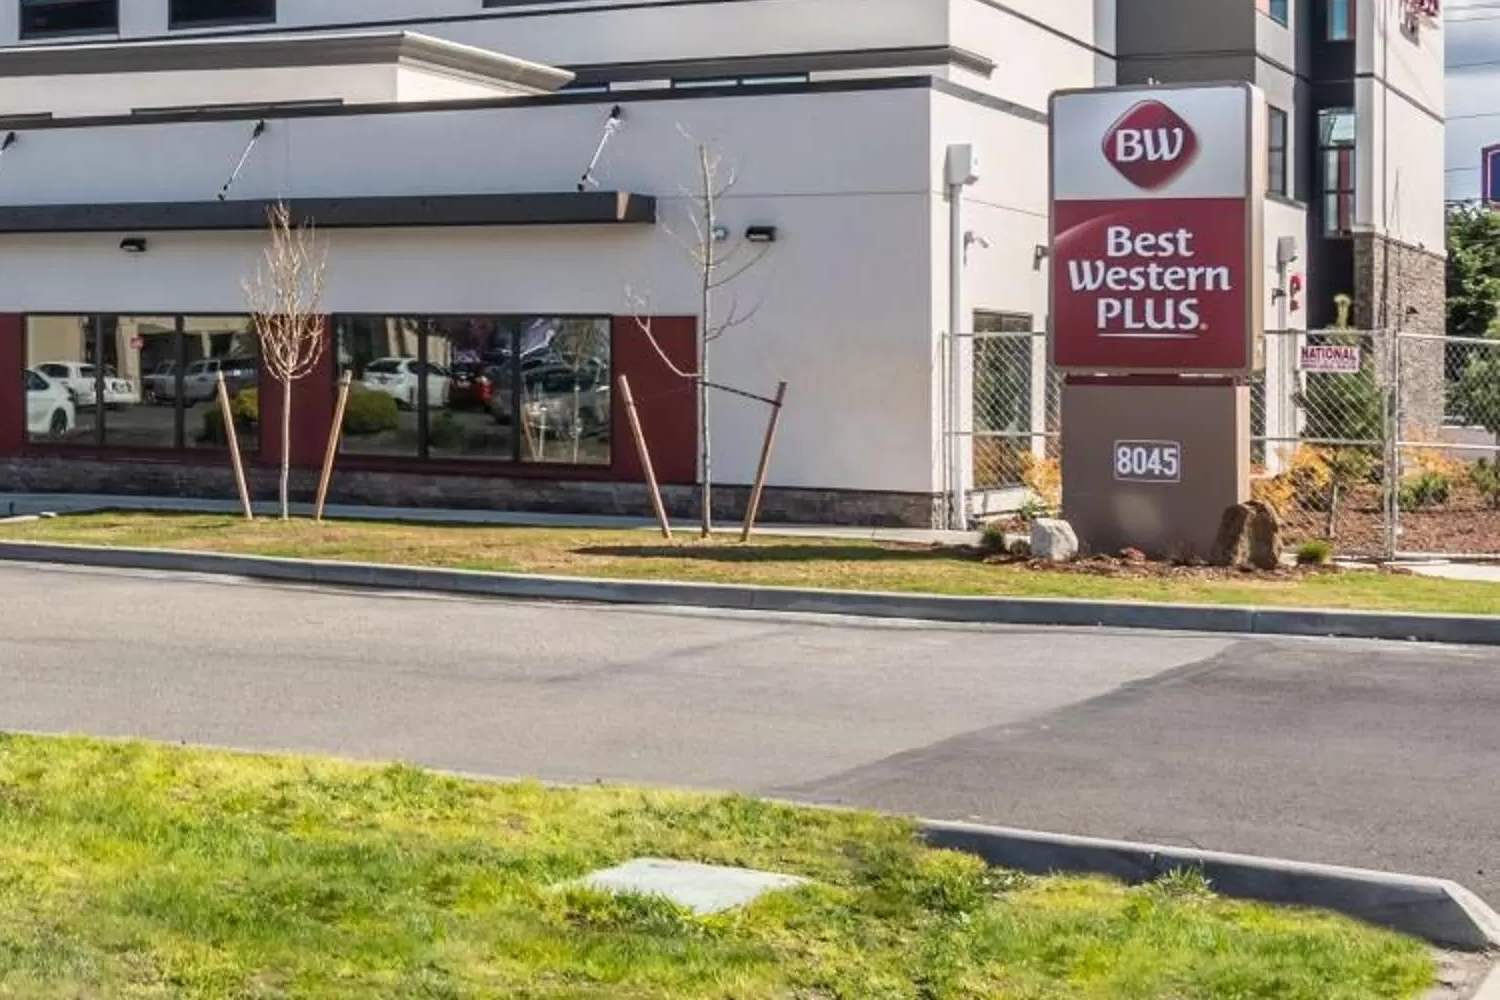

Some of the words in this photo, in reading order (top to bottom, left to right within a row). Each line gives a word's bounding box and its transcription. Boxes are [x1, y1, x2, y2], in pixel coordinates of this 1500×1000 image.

[1115, 127, 1184, 162] BW
[1106, 225, 1194, 257] Best
[1068, 260, 1232, 291] Western
[1097, 298, 1200, 330] PLUS
[1301, 347, 1356, 359] NATIONAL
[1117, 446, 1177, 476] 8045
